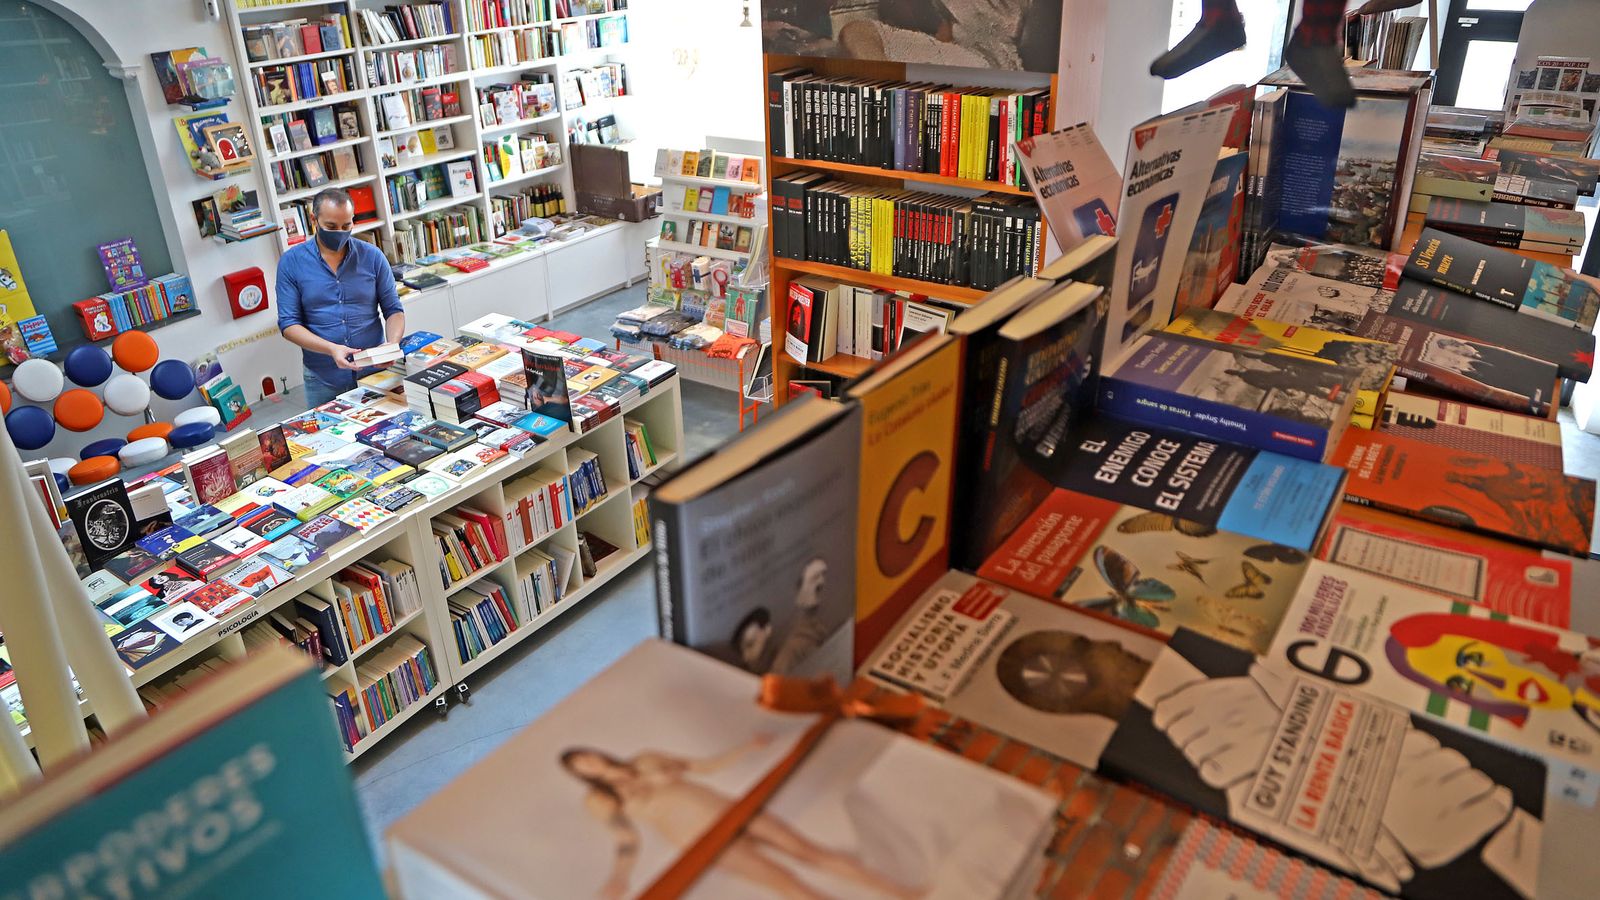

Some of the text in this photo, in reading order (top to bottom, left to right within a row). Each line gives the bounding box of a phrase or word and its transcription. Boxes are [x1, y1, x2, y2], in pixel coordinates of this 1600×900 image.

[1032, 159, 1074, 185] Alternativas
[1040, 174, 1080, 200] económicas
[1130, 148, 1183, 180] Alternativas
[1136, 398, 1248, 432] Timothy Snyder Tierras de sangre
[1080, 438, 1108, 454] EL
[1094, 430, 1152, 484] ENEMIGO
[1130, 438, 1182, 488] CONOCE
[76, 486, 120, 509] Frankenstein
[1155, 440, 1220, 512] EL SISTEMA
[874, 450, 940, 579] C
[994, 512, 1064, 577] La invención
[1019, 512, 1084, 584] del pasaporte
[218, 610, 259, 638] PSICOLOGÍA
[1316, 580, 1348, 640] ANDALUZAS
[896, 613, 957, 679] HISTORIA
[923, 623, 969, 679] UTOPÍA
[1254, 686, 1320, 812] GUY STANDING
[1306, 751, 1338, 805] RENTA
[1296, 799, 1319, 830] LA
